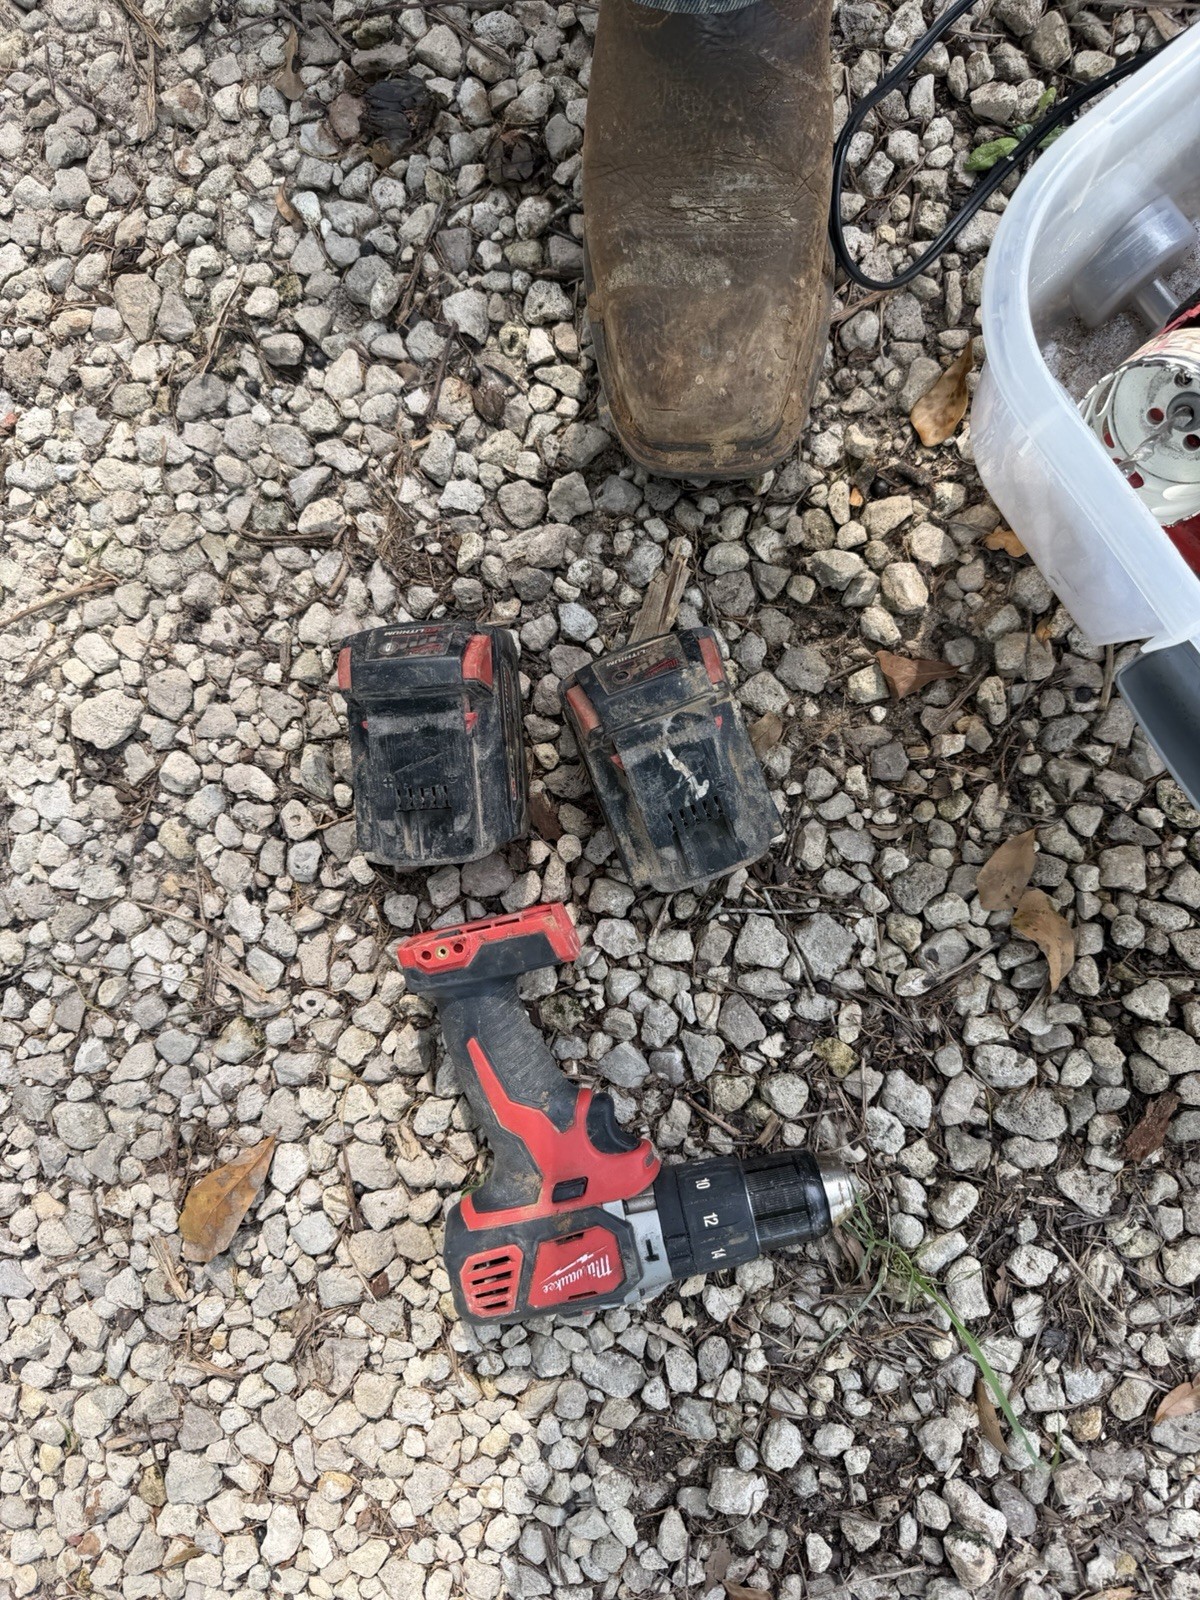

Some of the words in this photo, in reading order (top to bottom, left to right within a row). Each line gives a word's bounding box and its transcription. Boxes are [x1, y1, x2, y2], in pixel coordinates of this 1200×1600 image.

[695, 1178, 711, 1190] 10
[703, 1212, 719, 1228] 12
[711, 1247, 727, 1260] 14
